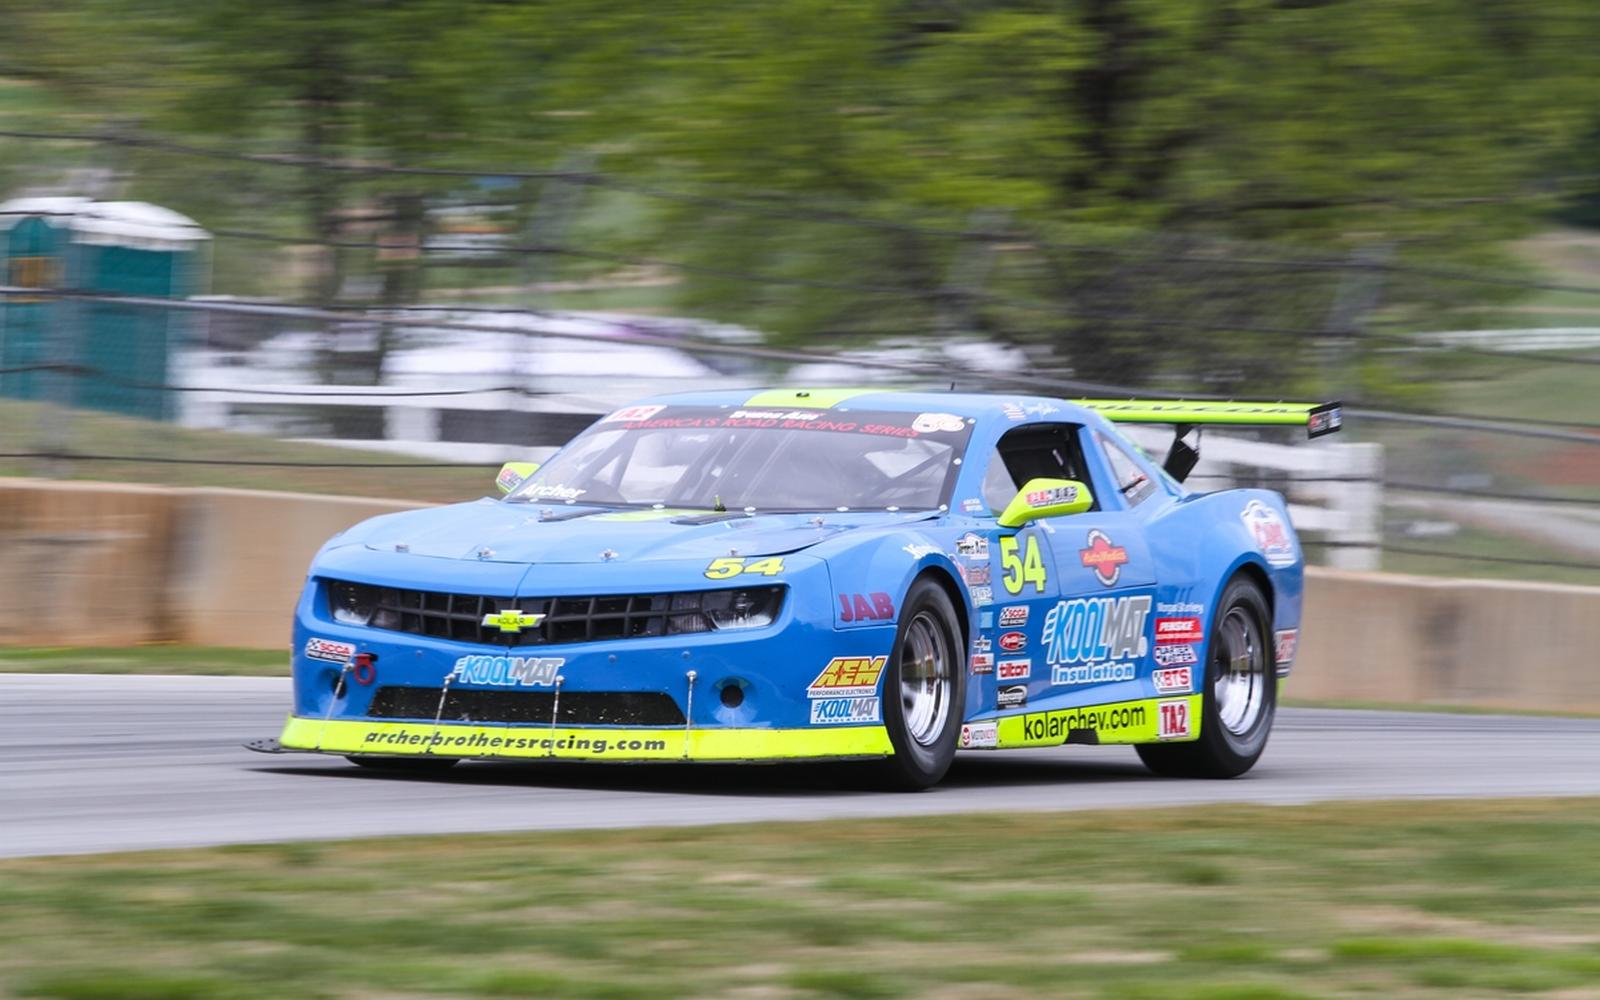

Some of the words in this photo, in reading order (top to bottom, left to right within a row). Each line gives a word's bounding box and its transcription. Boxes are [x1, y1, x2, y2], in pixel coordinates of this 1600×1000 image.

[621, 418, 720, 430] AMERICA'S
[721, 418, 777, 429] ROAD
[780, 419, 856, 432] RACING
[859, 424, 919, 438] SERIES
[517, 482, 586, 498] Archer
[703, 556, 785, 580] 54
[1000, 535, 1047, 595] 54
[838, 592, 896, 623] JAB
[497, 617, 526, 625] KOLAR
[1047, 595, 1152, 664] KOOLMAT
[319, 642, 351, 655] SCCA
[457, 655, 566, 686] KOOLMAT
[811, 657, 887, 688] AEM
[1051, 661, 1136, 685] Insulation
[810, 688, 845, 696] PERFORMANCE
[816, 698, 878, 719] KOOLMAT
[1161, 703, 1187, 735] TA2
[1024, 705, 1146, 741] kolarchev.com
[364, 730, 667, 753] archerbrothersracing.com
